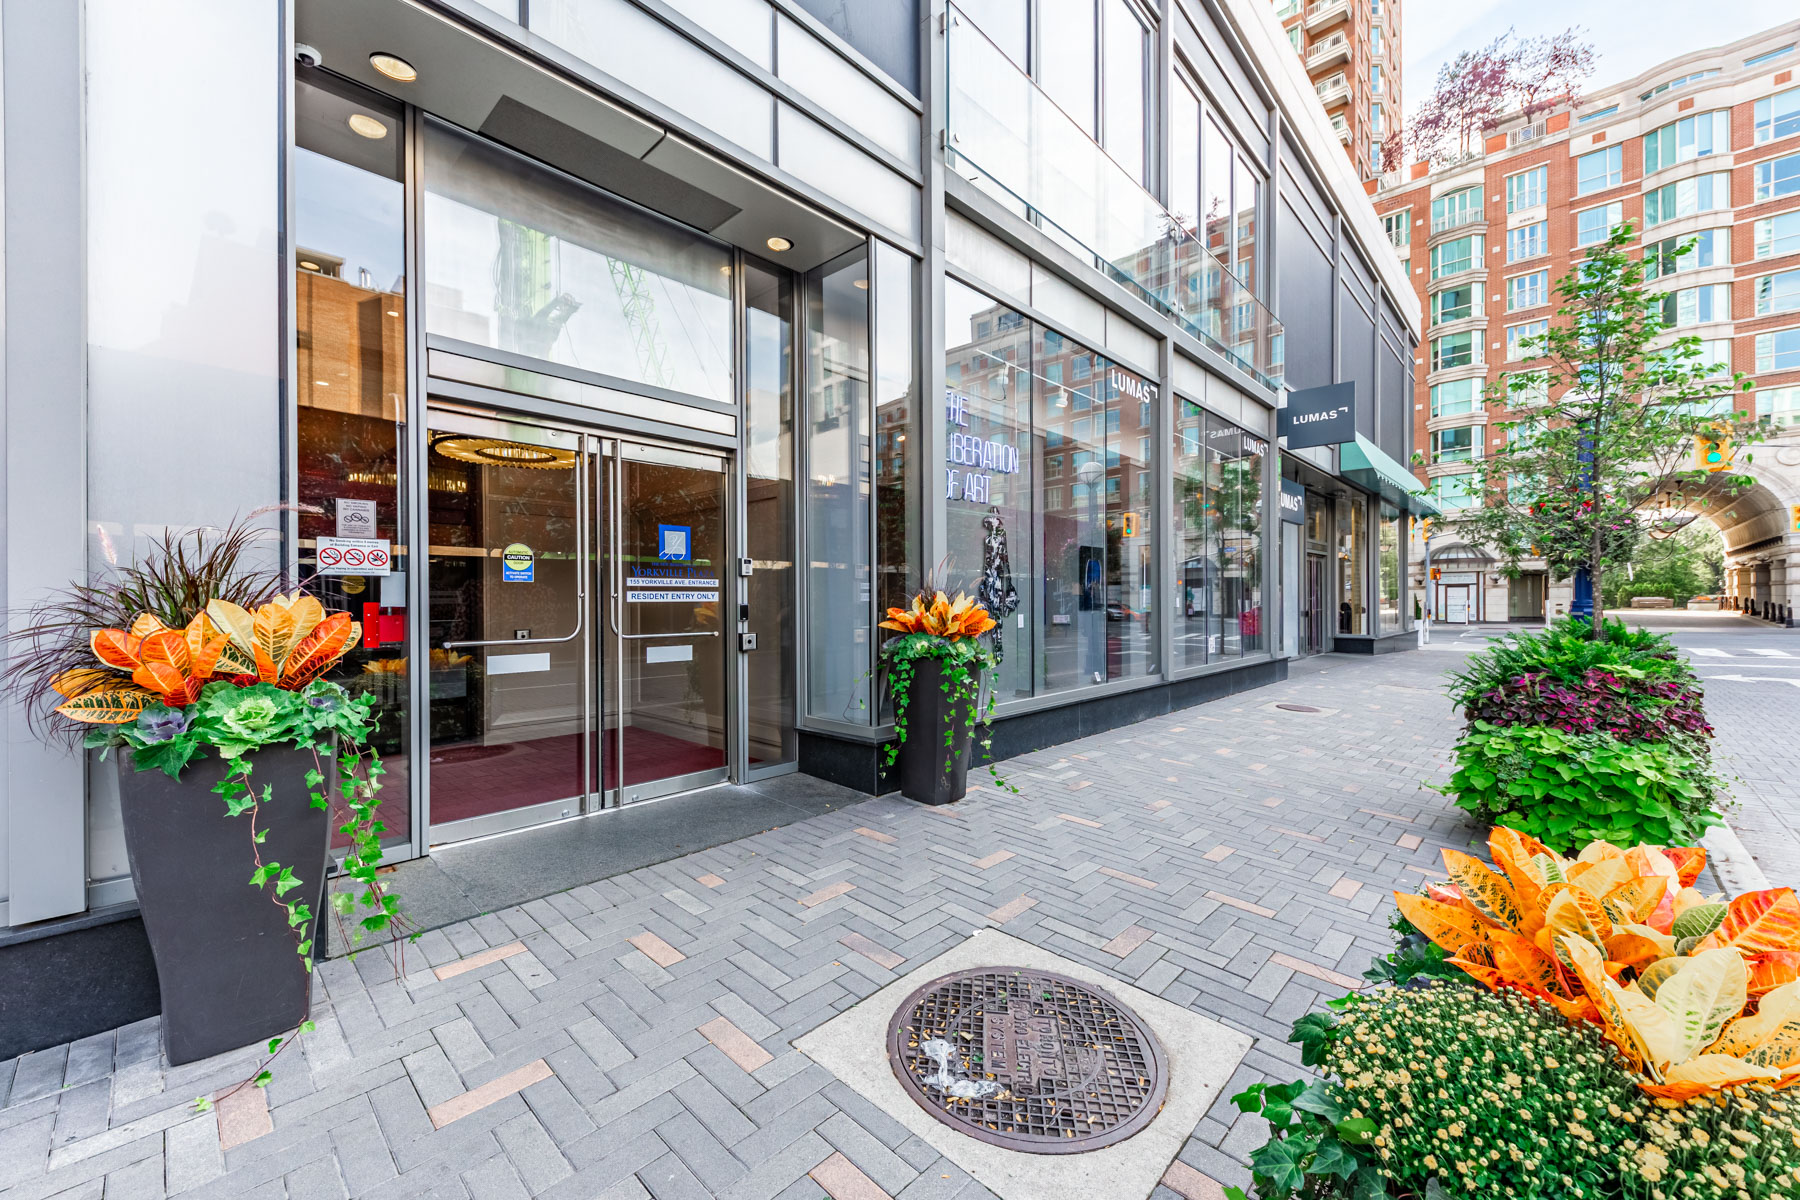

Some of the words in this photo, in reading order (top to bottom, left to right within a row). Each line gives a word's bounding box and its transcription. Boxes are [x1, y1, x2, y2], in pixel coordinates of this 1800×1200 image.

[1111, 368, 1151, 403] LUMAS
[946, 390, 969, 427] HE
[1293, 410, 1338, 425] LUMAS
[946, 432, 1020, 474] IBERATION
[1243, 435, 1265, 457] LUMAS
[964, 472, 992, 504] ART
[1280, 491, 1299, 512] UMAS
[631, 566, 682, 577] YORKVILLE
[990, 1017, 1006, 1070] SYSTEM
